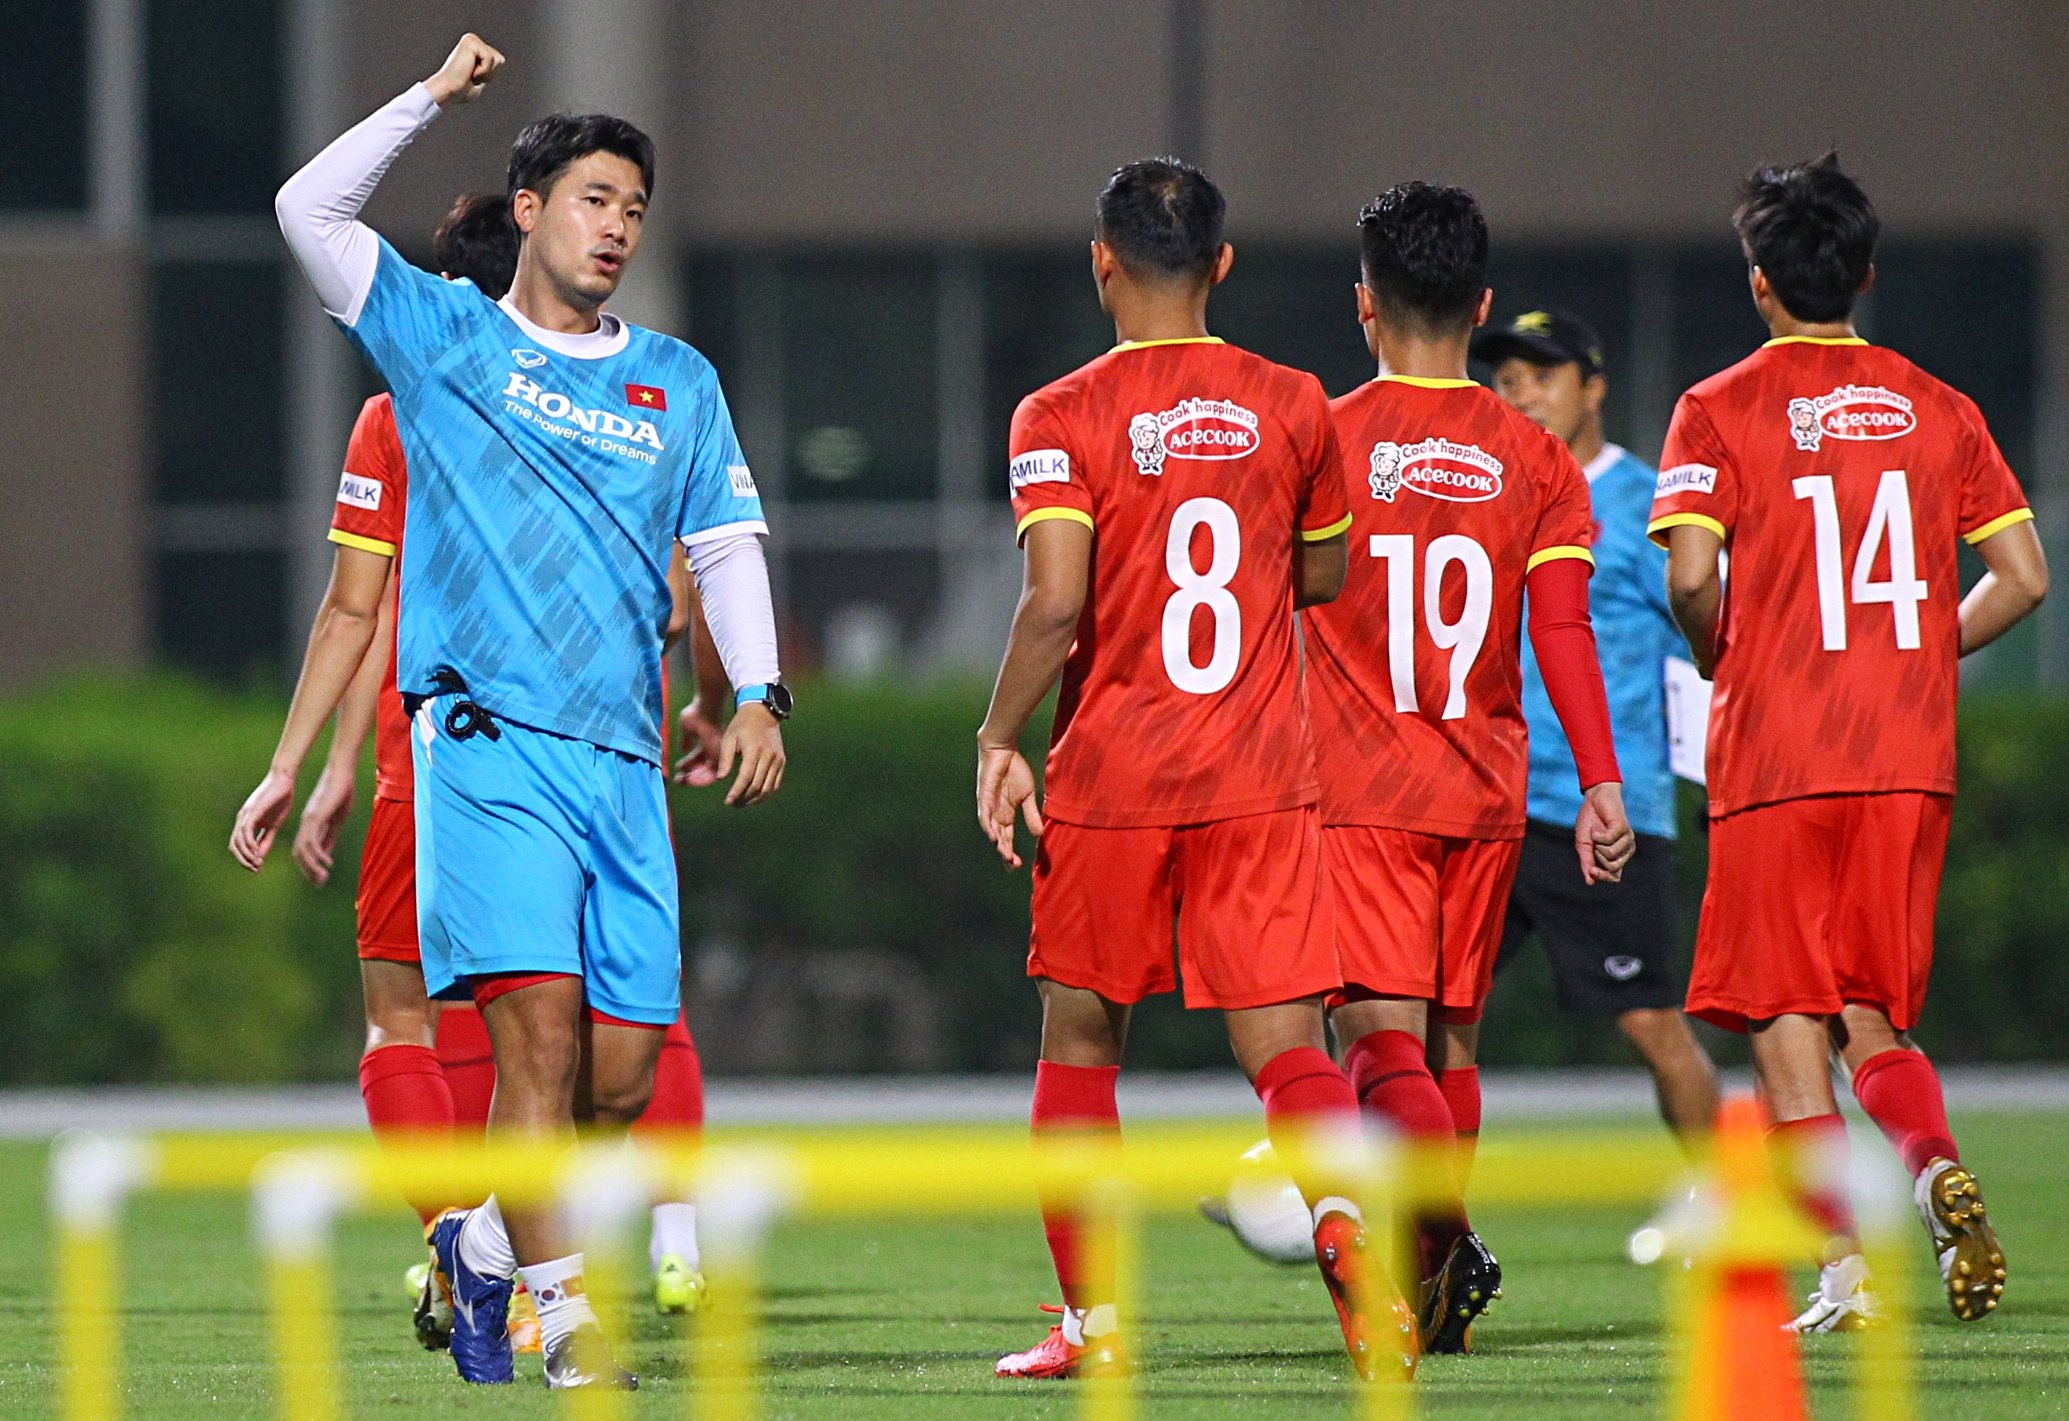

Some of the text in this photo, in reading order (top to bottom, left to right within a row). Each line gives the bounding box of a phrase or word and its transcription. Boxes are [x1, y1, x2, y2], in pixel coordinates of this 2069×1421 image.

[502, 371, 665, 451] HONDA
[1160, 399, 1256, 427] Cook happiness
[1816, 388, 1909, 410] Cook happiness
[505, 400, 657, 466] The Power of Dreams
[1402, 439, 1502, 473] Cook happiness
[1010, 458, 1065, 489] AMILK
[1791, 470, 1929, 651] 14
[1161, 496, 1241, 695] 8
[1369, 534, 1493, 720] 19
